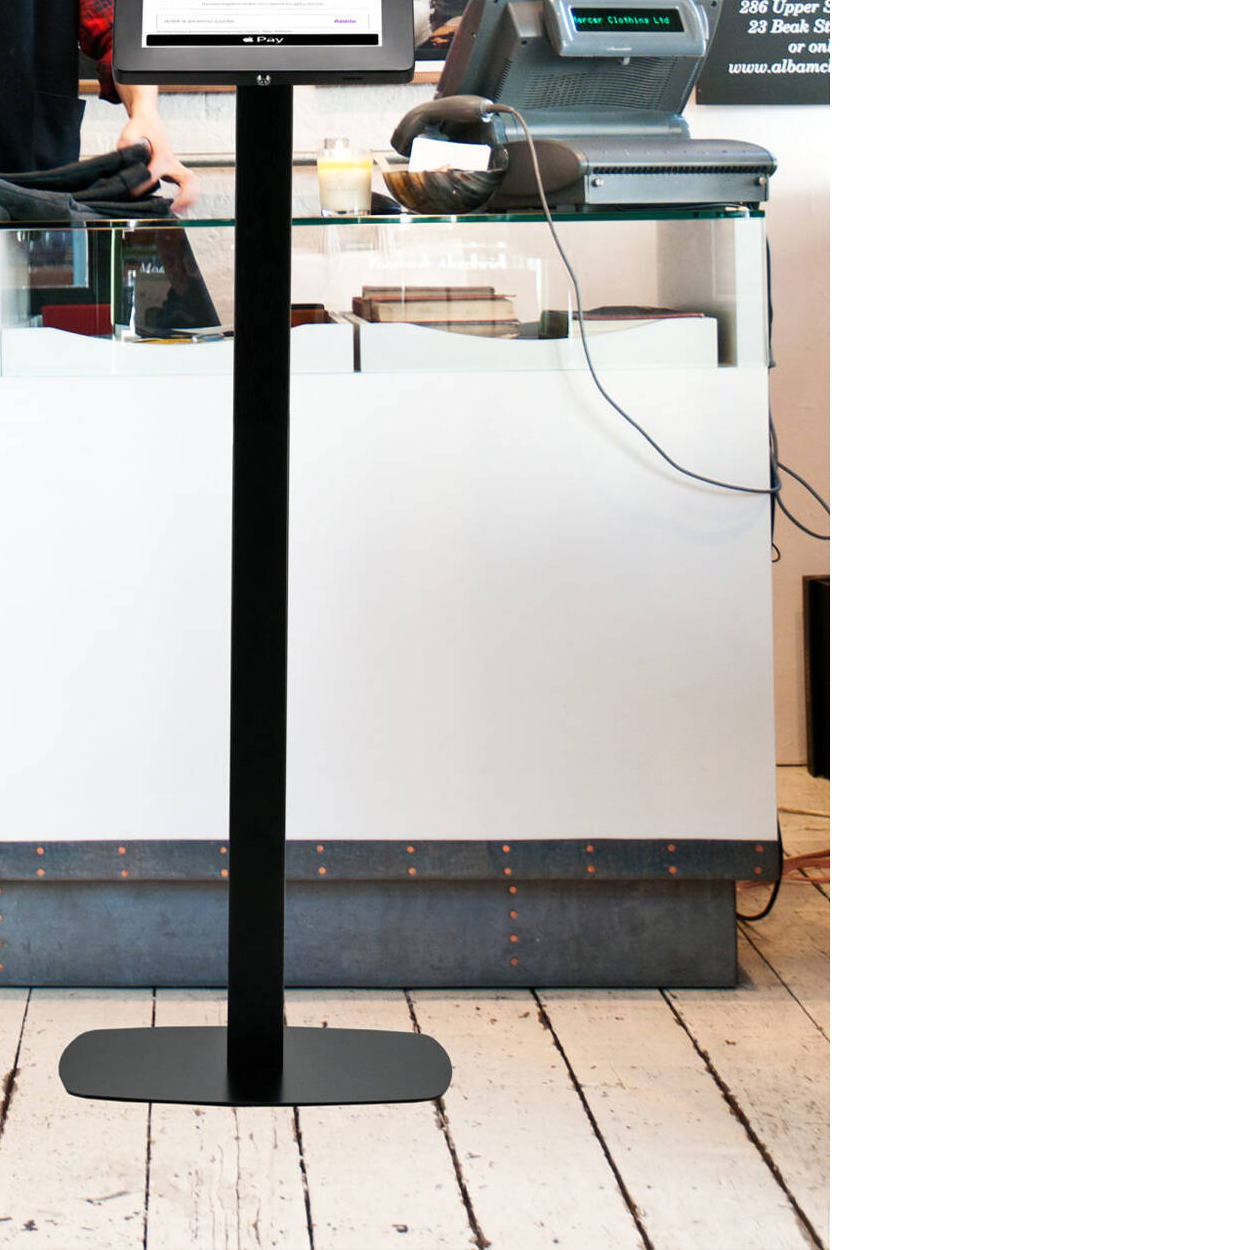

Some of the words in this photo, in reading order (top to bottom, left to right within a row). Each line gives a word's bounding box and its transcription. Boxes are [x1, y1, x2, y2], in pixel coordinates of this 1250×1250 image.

[739, 0, 769, 14] 286
[772, 0, 820, 17] Upper
[747, 20, 768, 34] 23
[770, 19, 810, 34] Beak
[257, 36, 284, 44] Pay
[788, 42, 806, 53] or
